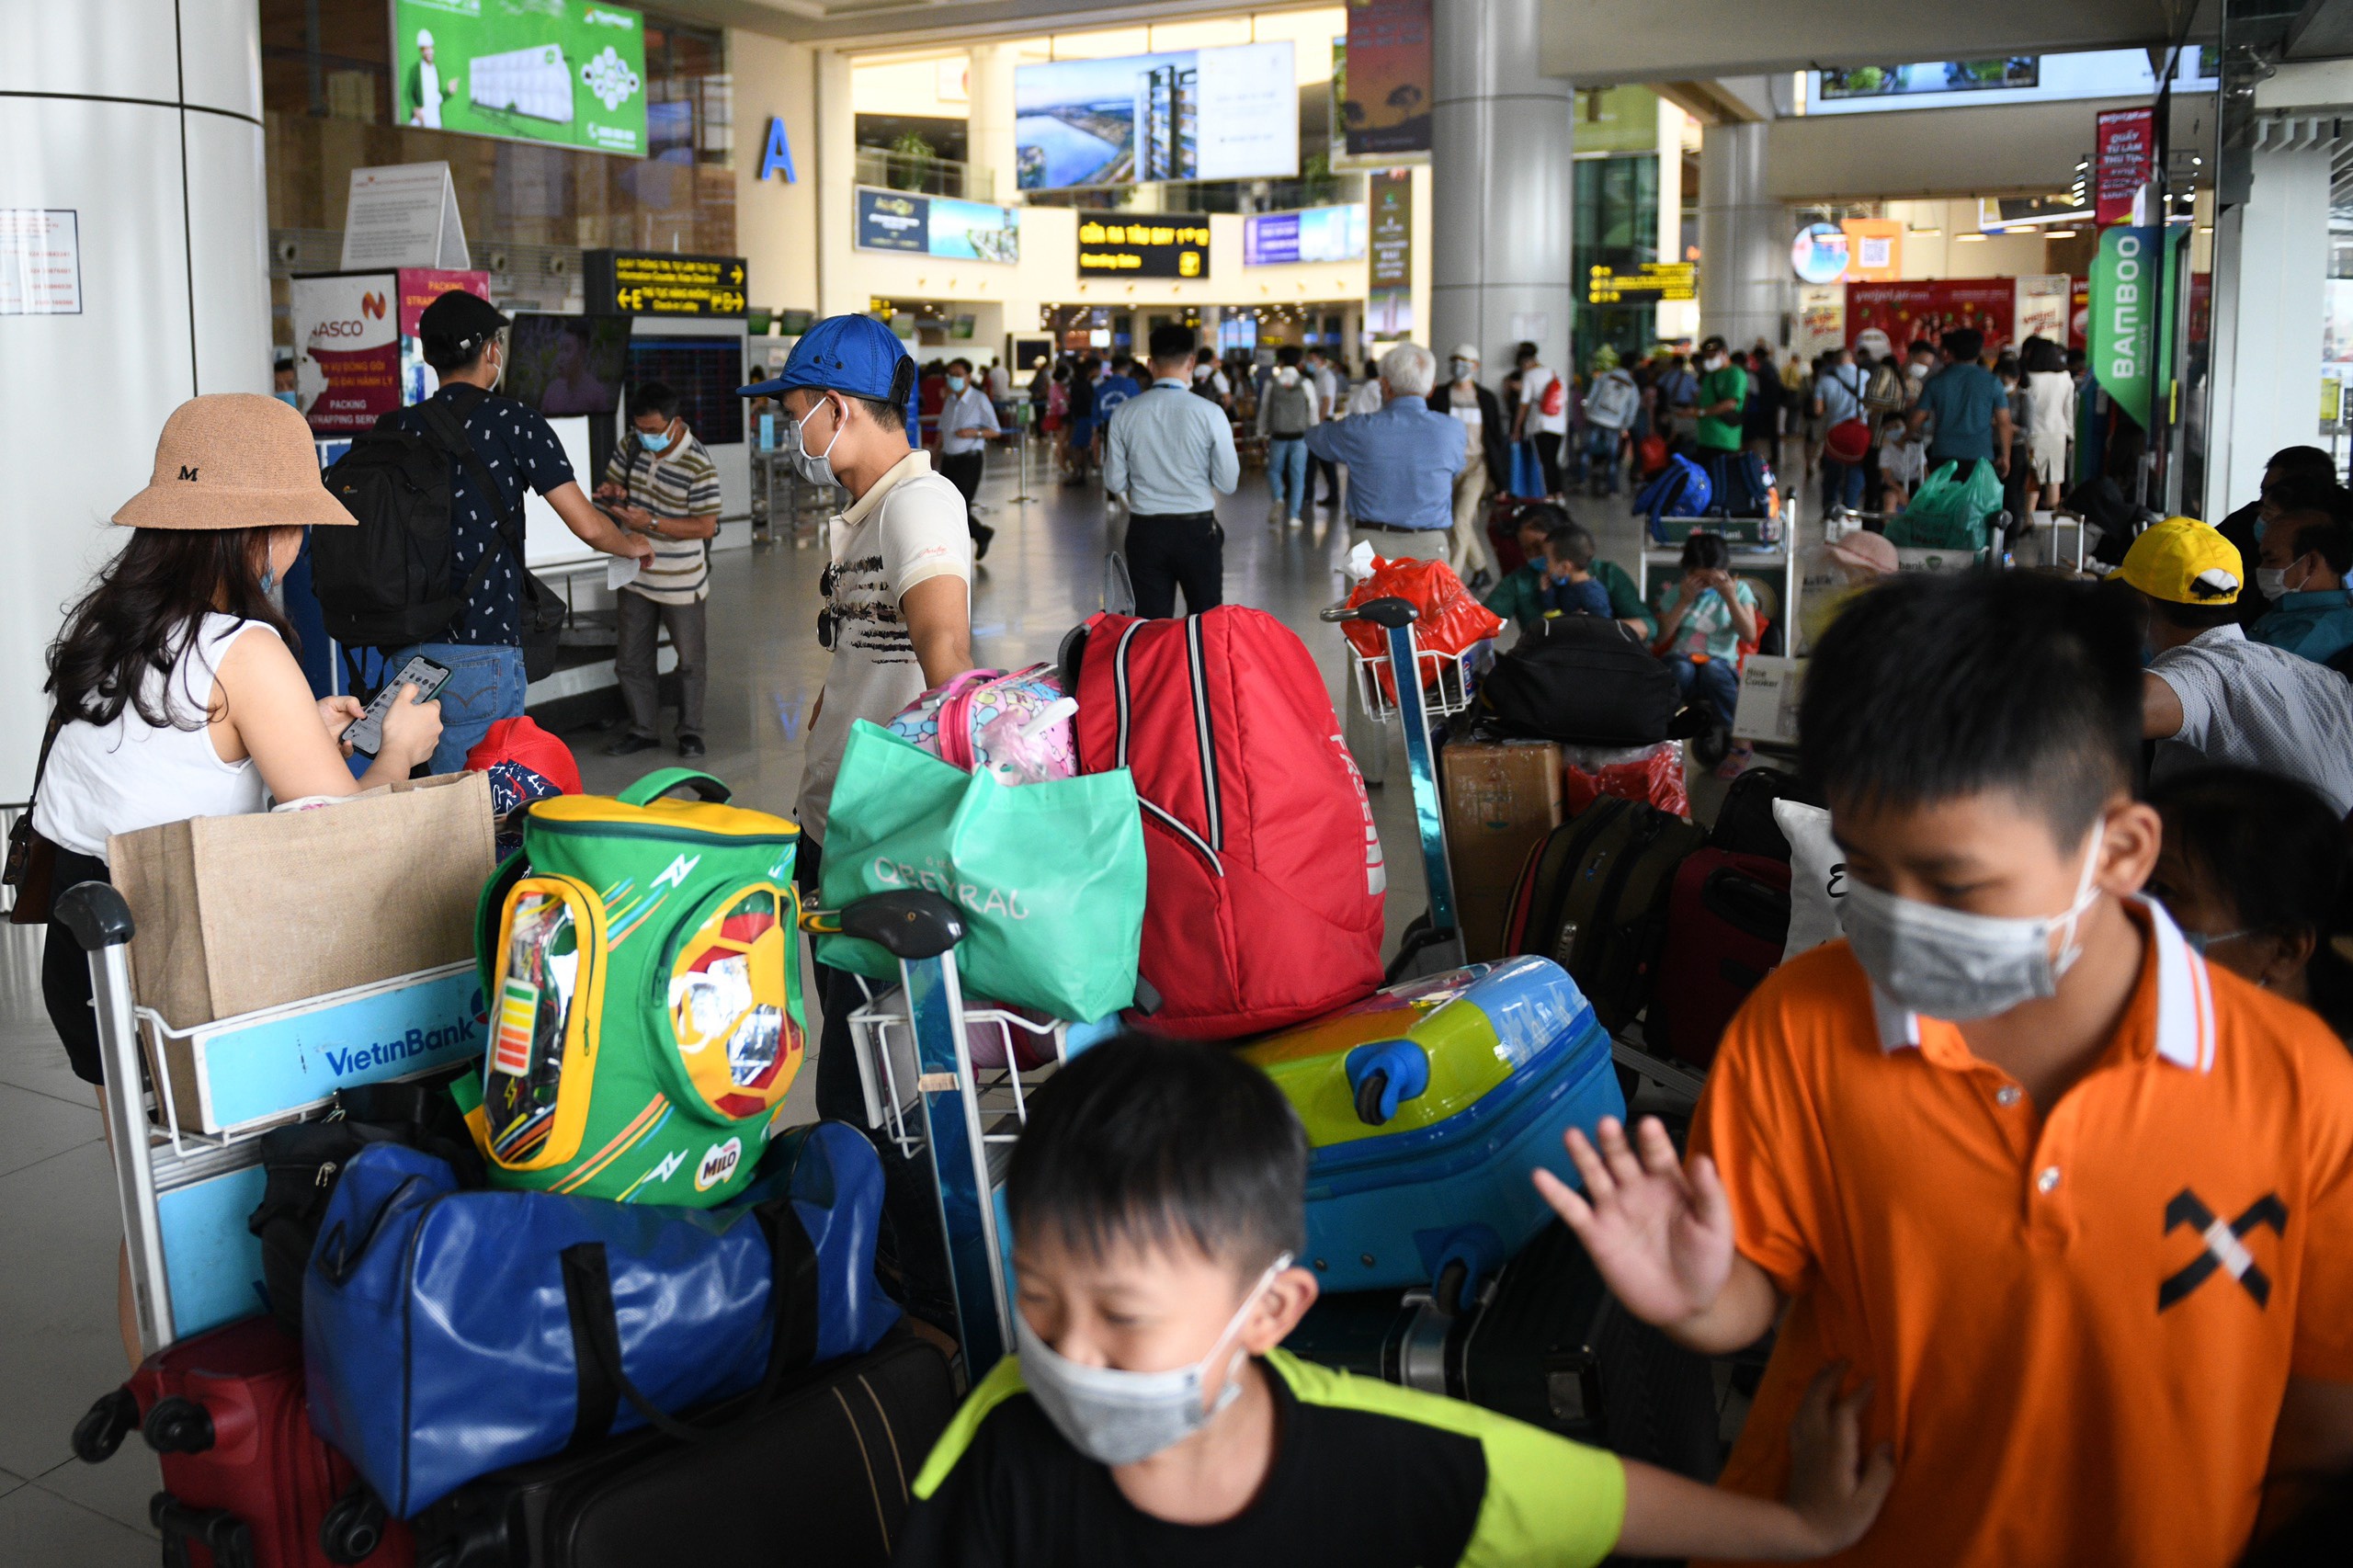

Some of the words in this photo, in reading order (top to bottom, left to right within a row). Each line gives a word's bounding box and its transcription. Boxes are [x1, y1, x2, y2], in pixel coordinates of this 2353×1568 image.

[761, 117, 798, 184] A
[2112, 235, 2141, 379] BAMBOO
[330, 399, 367, 410] PACKING
[177, 464, 199, 483] M
[1745, 677, 1779, 688] Cooker
[325, 1017, 476, 1077] VietinBank
[702, 1151, 737, 1180] MILO
